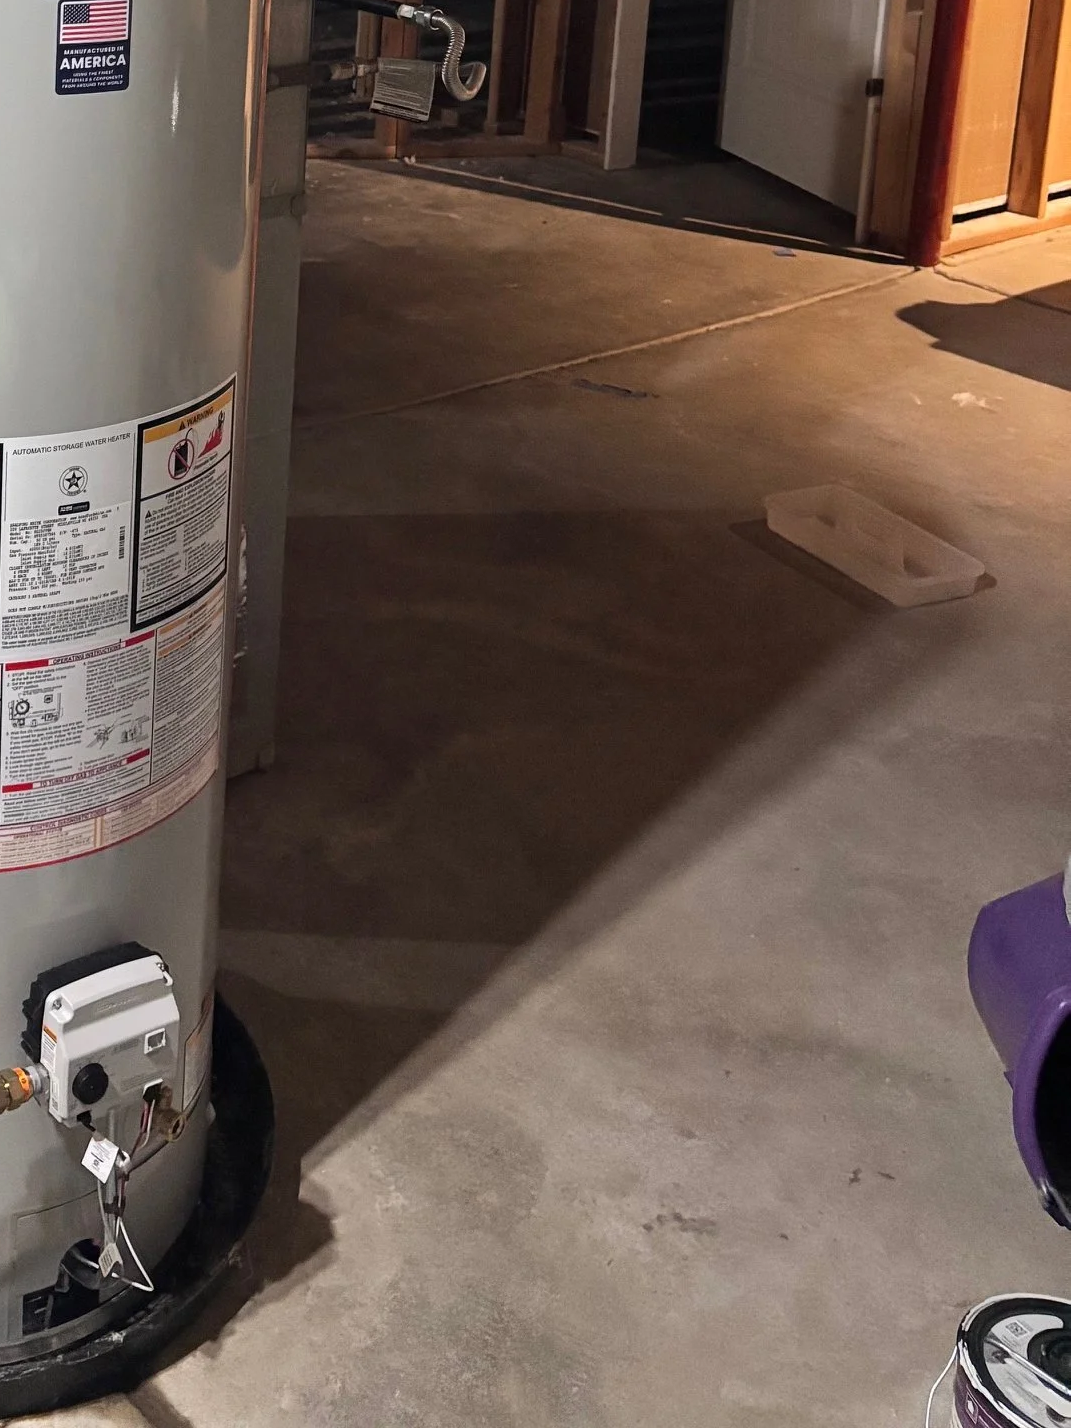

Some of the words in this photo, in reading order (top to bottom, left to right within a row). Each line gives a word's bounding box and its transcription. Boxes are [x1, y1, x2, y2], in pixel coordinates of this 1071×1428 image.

[60, 54, 126, 70] AMERICA
[187, 407, 213, 427] WARNING
[13, 447, 51, 455] AUTOMATIC
[53, 442, 83, 452] STORAGE
[85, 438, 107, 447] WATER
[108, 433, 131, 442] HEATER
[53, 652, 83, 664] OPERATING
